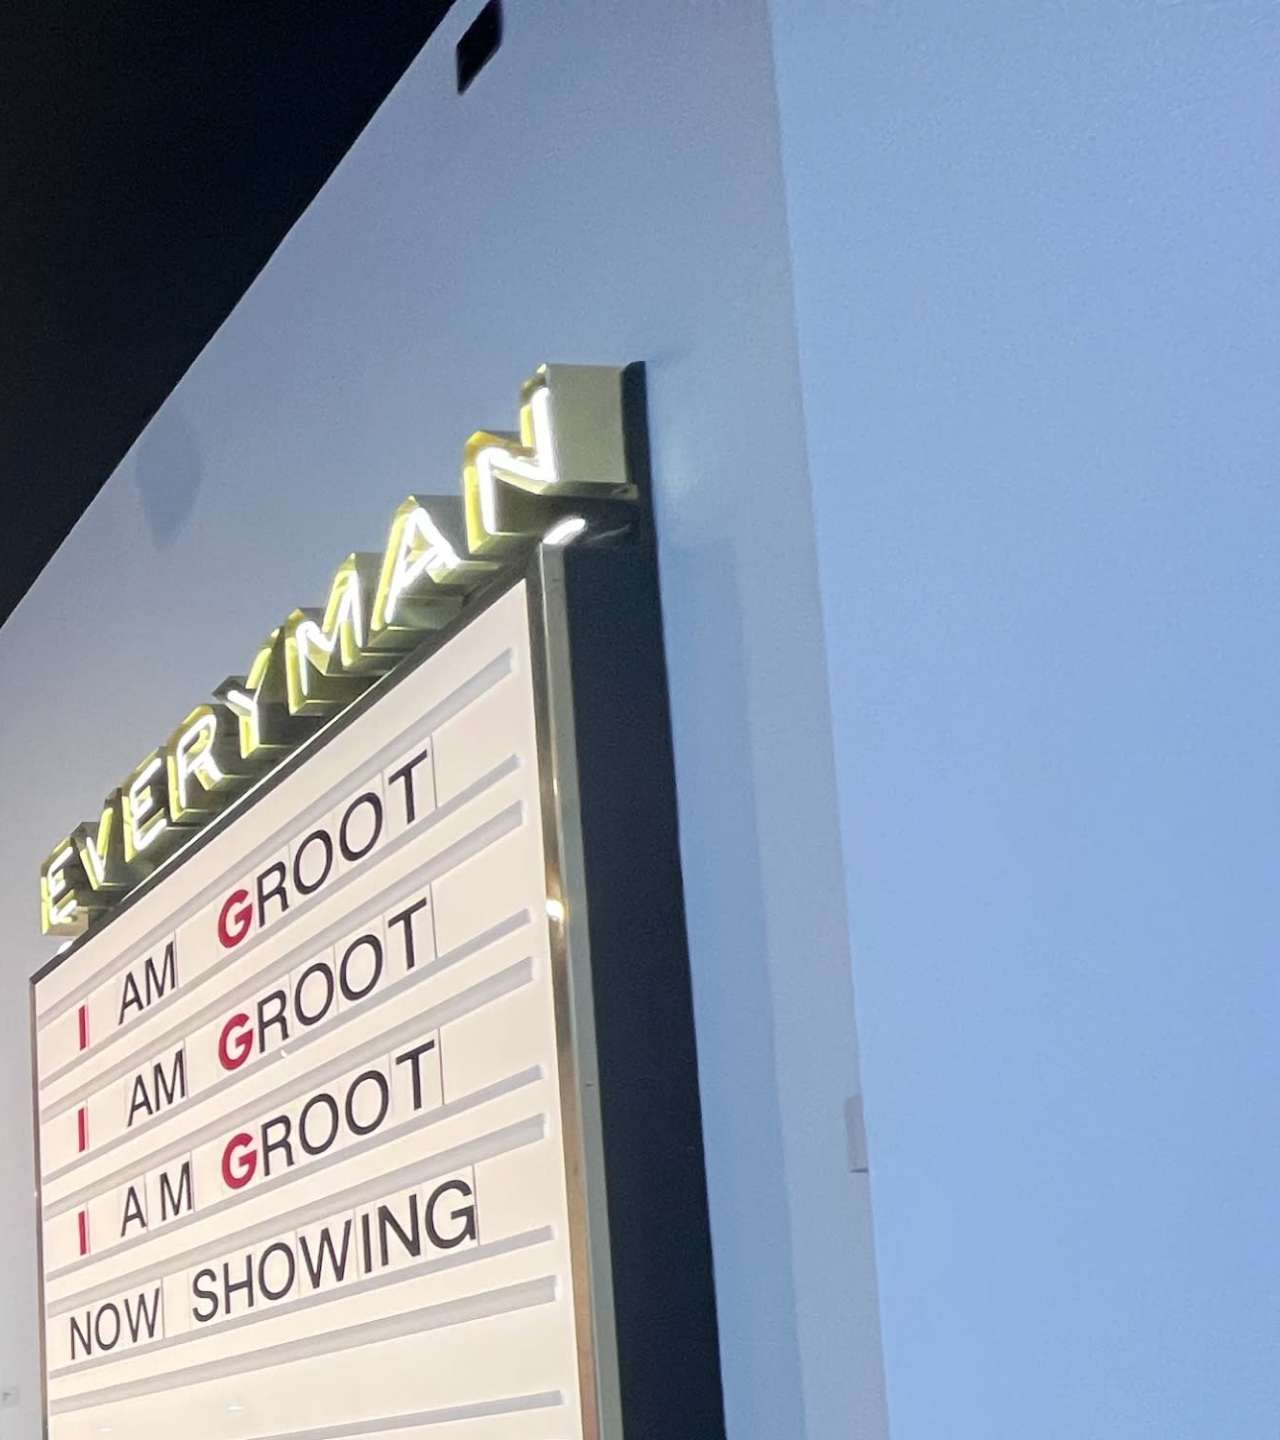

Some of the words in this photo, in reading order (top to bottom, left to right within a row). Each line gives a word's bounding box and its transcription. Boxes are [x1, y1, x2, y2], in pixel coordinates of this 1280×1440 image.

[40, 364, 564, 936] EVERYMAN
[76, 1106, 88, 1153] I
[125, 1050, 187, 1128] AM
[217, 897, 429, 1071] GROOT
[77, 1004, 88, 1052] I
[117, 943, 178, 1026] AM
[217, 750, 428, 949] GROOT
[69, 1286, 161, 1361] NOW
[191, 1179, 478, 1323] SHOWING
[77, 1210, 88, 1255] I
[119, 1160, 194, 1239] AM
[221, 1038, 436, 1190] GROOT
